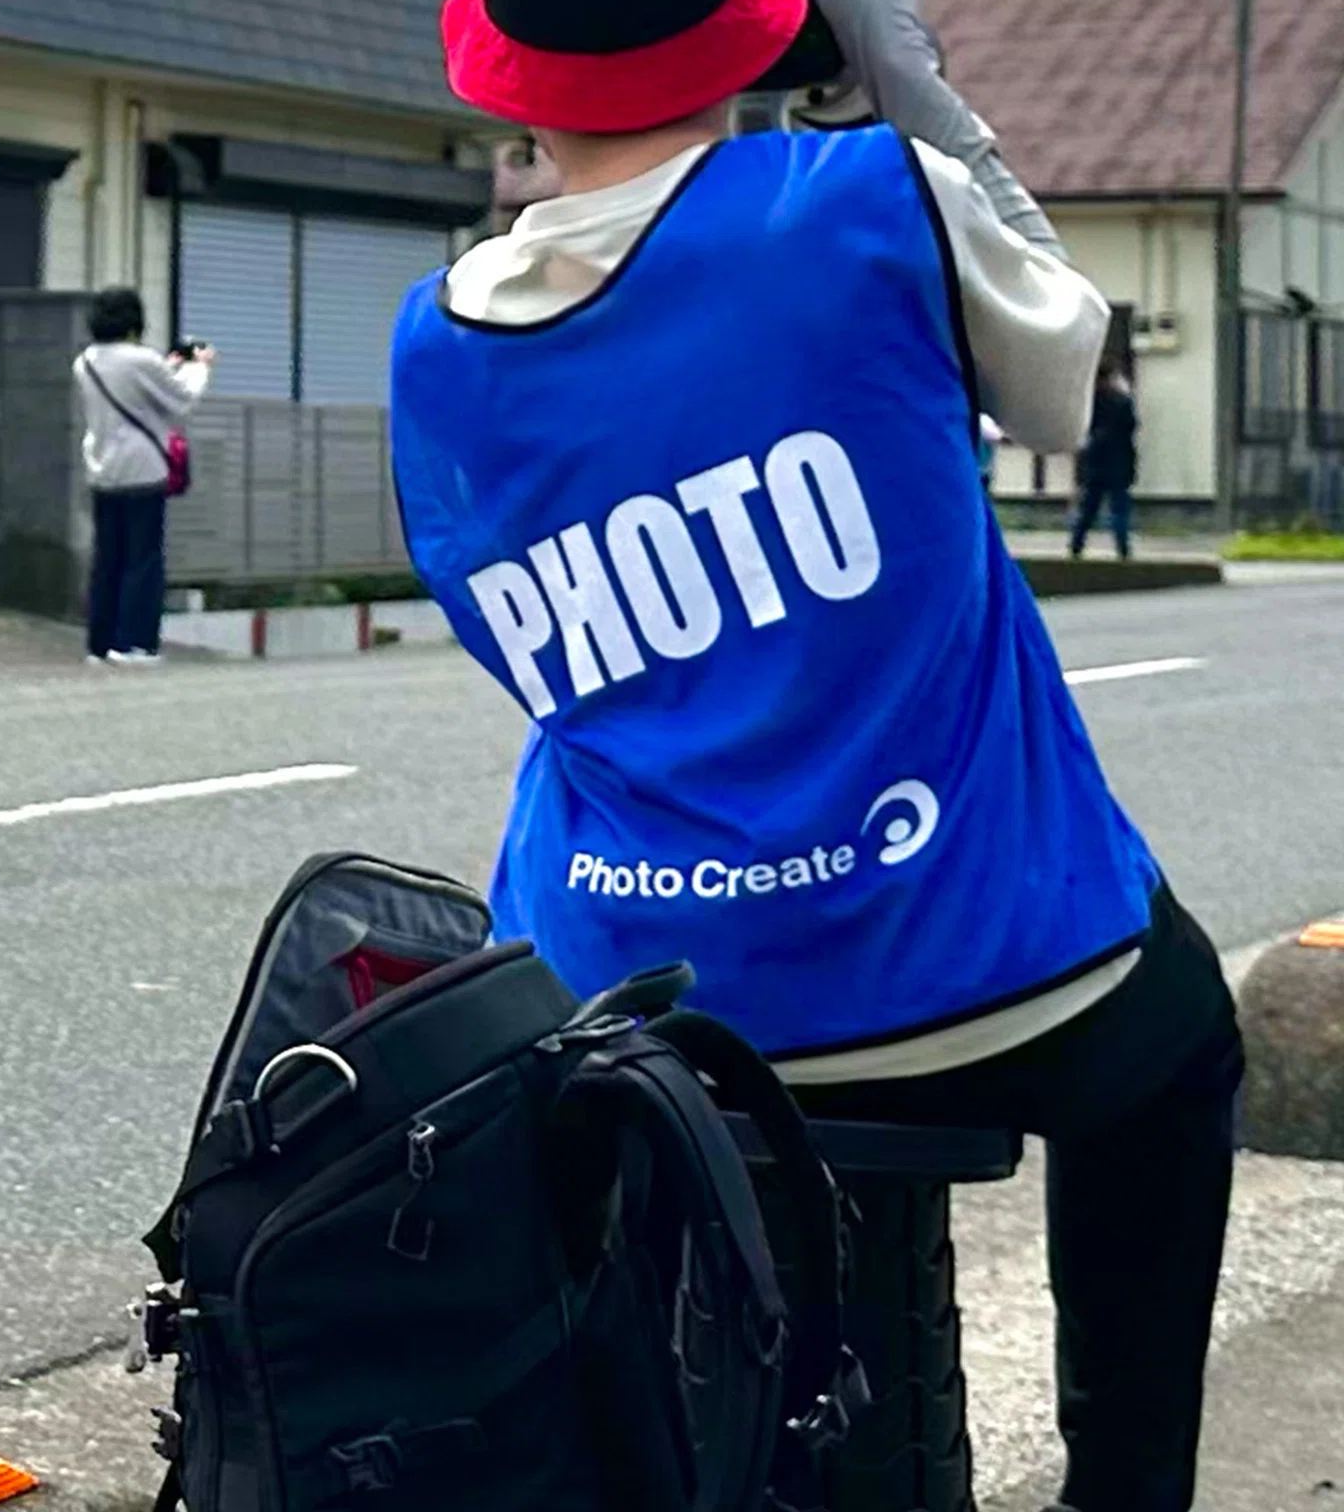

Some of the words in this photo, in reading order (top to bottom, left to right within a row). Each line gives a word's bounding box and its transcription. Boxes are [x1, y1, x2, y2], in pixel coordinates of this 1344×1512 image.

[467, 430, 882, 720] PHOTO
[567, 852, 684, 898] Photo
[691, 844, 856, 899] Create
